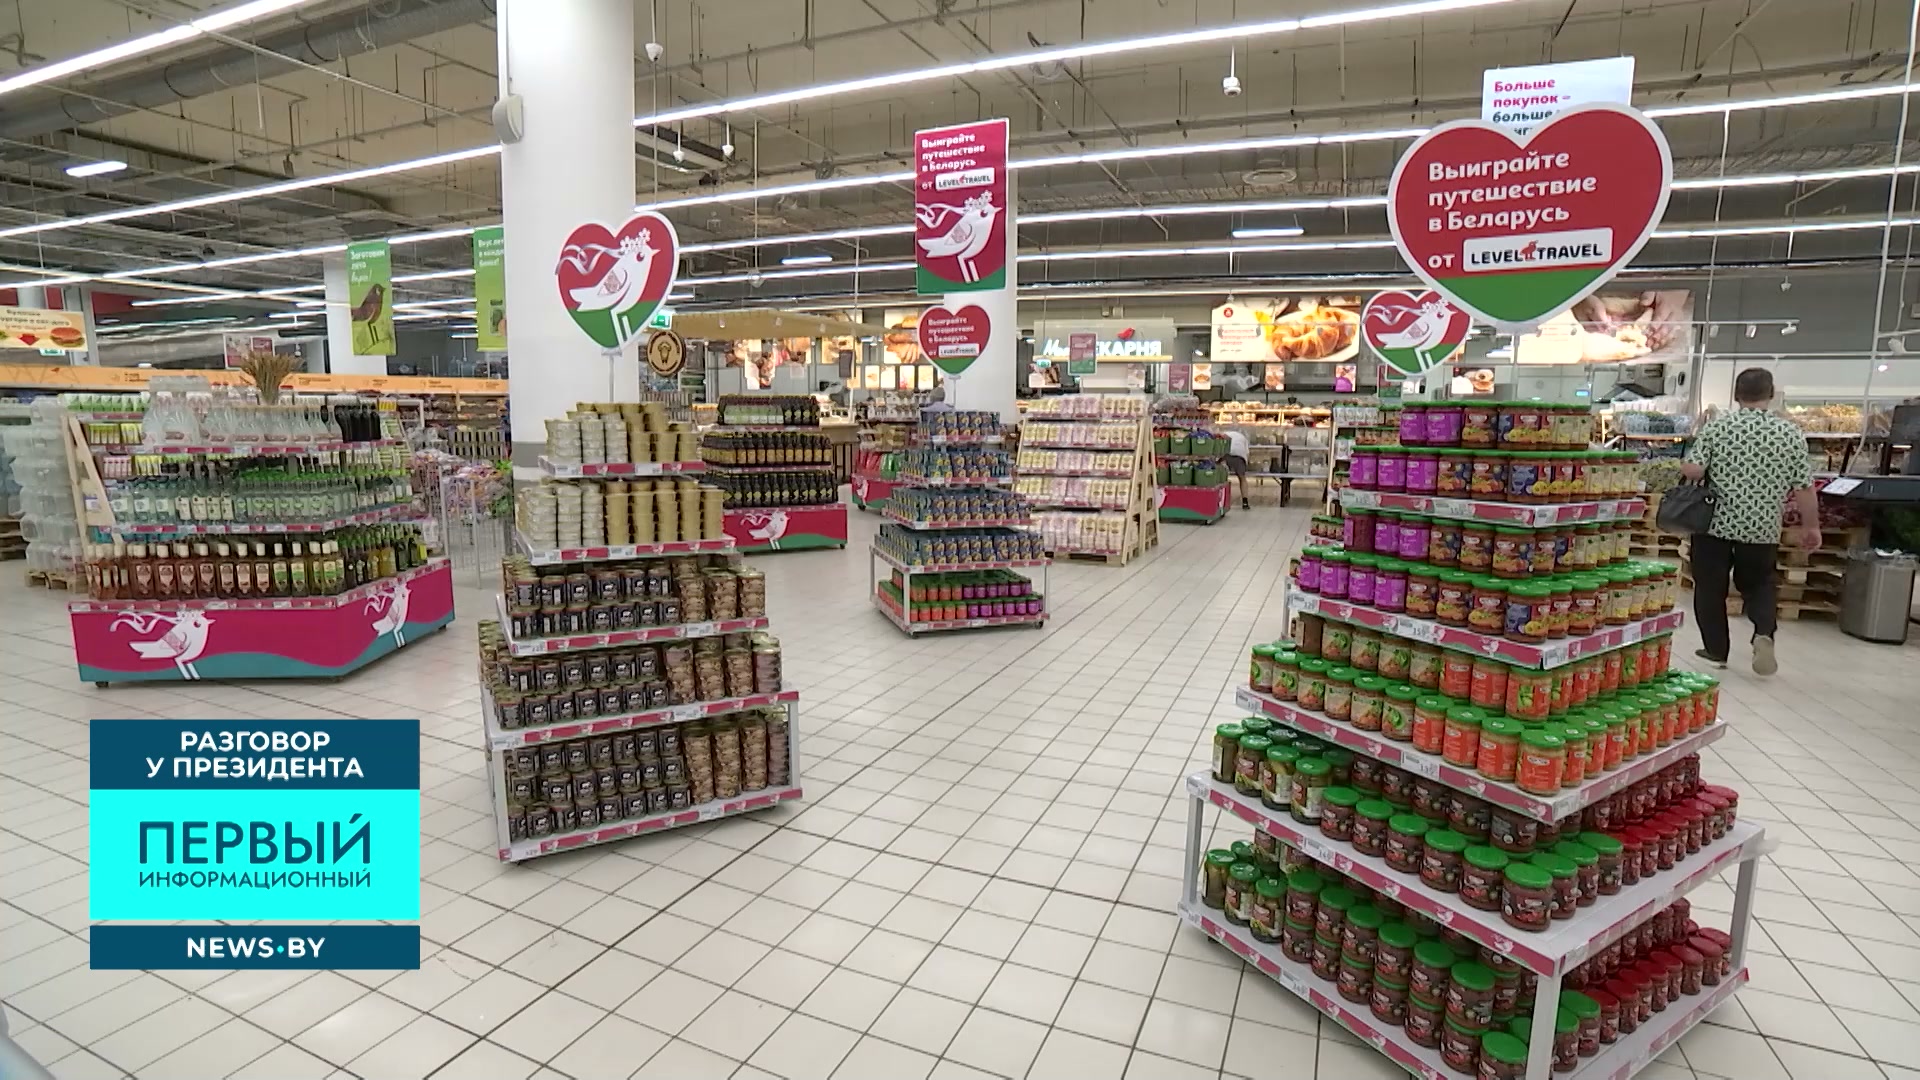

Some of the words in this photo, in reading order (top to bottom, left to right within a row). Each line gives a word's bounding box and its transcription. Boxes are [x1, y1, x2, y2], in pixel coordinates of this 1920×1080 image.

[1494, 79, 1556, 93] Больше
[1493, 95, 1559, 109] покупок
[1492, 110, 1553, 123] больше
[921, 133, 976, 148] Выиграйте
[922, 145, 986, 161] путешествие
[929, 159, 977, 171] Беларусь
[1428, 150, 1571, 182] Выиграйте
[1428, 176, 1598, 210] путешествие
[1428, 217, 1443, 232] в
[1447, 206, 1571, 231] Беларусь
[1427, 253, 1456, 268] от
[1471, 249, 1523, 265] LEVEL
[1537, 243, 1603, 260] TRAVEL
[1096, 340, 1161, 356] КАРНЯ
